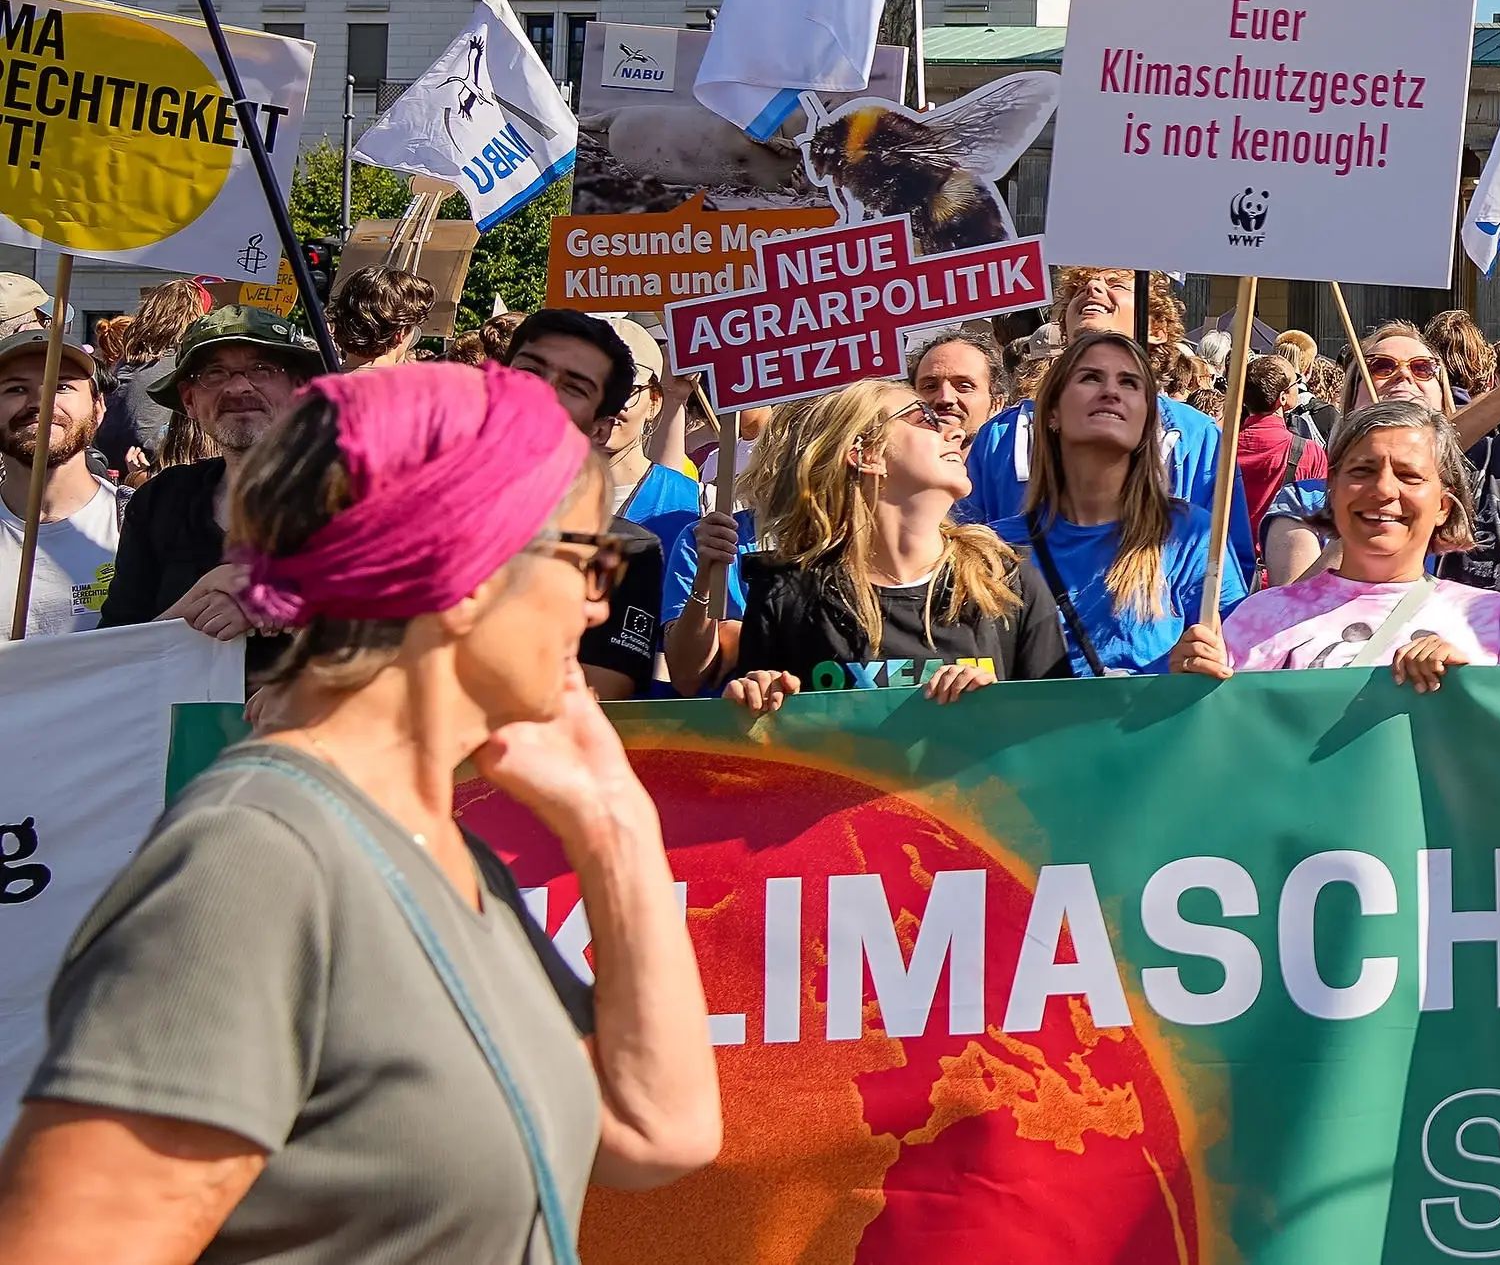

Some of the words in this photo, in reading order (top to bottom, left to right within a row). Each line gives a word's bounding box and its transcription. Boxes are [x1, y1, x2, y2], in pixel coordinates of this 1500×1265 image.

[621, 67, 665, 81] NABU
[1100, 48, 1426, 113] Klimaschutzgesetz
[1123, 112, 1152, 155] is
[1163, 119, 1220, 159] not
[1231, 115, 1389, 176] kenough!
[566, 224, 712, 257] Gesunde
[775, 234, 897, 289] NEUE
[1227, 234, 1266, 248] WWF
[246, 287, 283, 302] WELT
[565, 267, 664, 298] Klima
[670, 264, 734, 295] und
[689, 255, 1034, 354] AGRARPOLITIK
[730, 330, 884, 394] JETZT!
